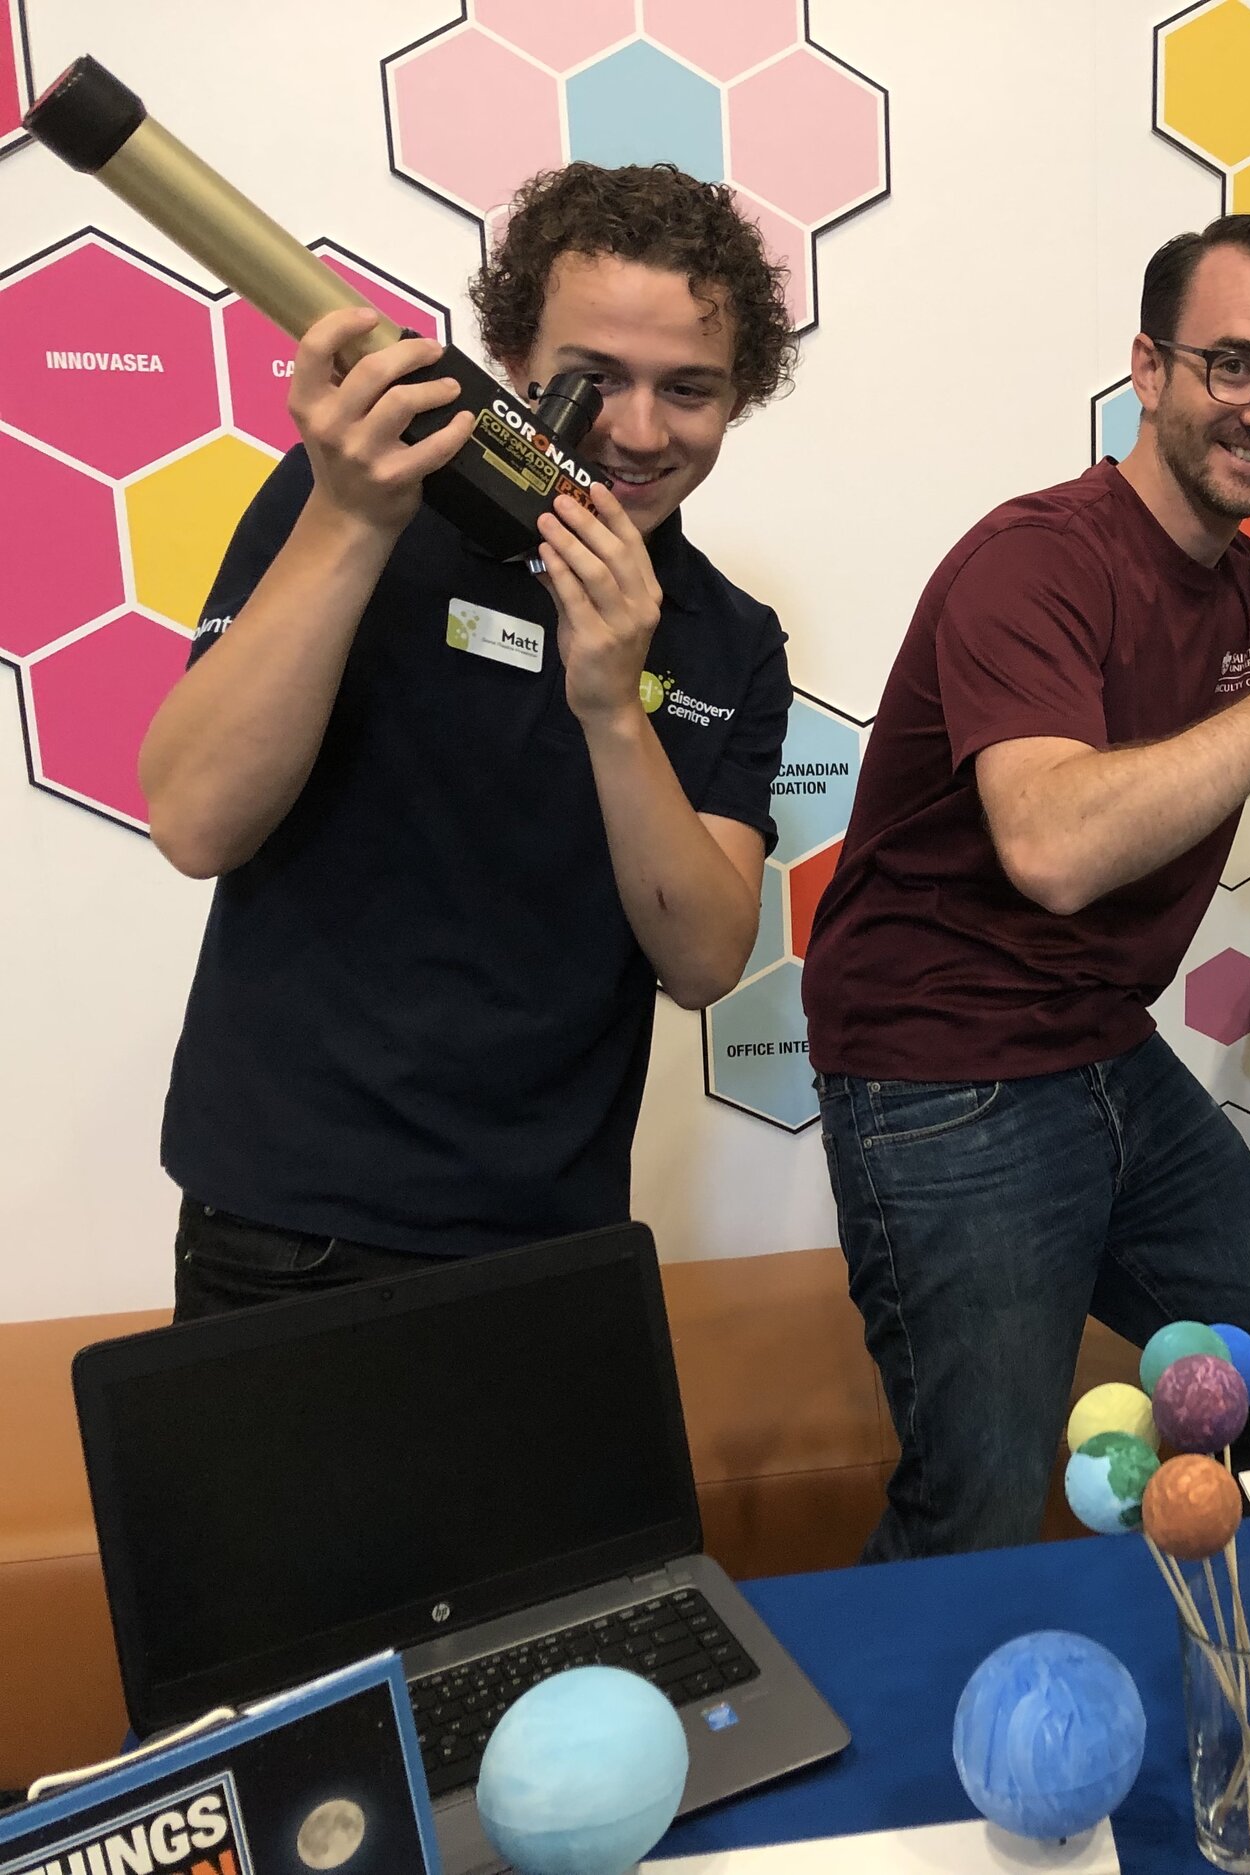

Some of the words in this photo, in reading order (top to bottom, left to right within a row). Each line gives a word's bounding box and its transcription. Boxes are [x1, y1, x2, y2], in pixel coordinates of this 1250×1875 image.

[45, 350, 164, 373] INNOVASEA
[482, 415, 554, 476] CORONADO
[492, 399, 591, 487] CORONAD
[501, 628, 539, 653] Matt
[667, 704, 710, 727] centre
[669, 689, 735, 721] discovery
[778, 762, 849, 778] CANADIAN
[727, 1042, 775, 1058] OFFICE
[779, 1040, 809, 1055] INTE
[434, 1604, 449, 1621] hp
[14, 1796, 227, 1875] INGS
